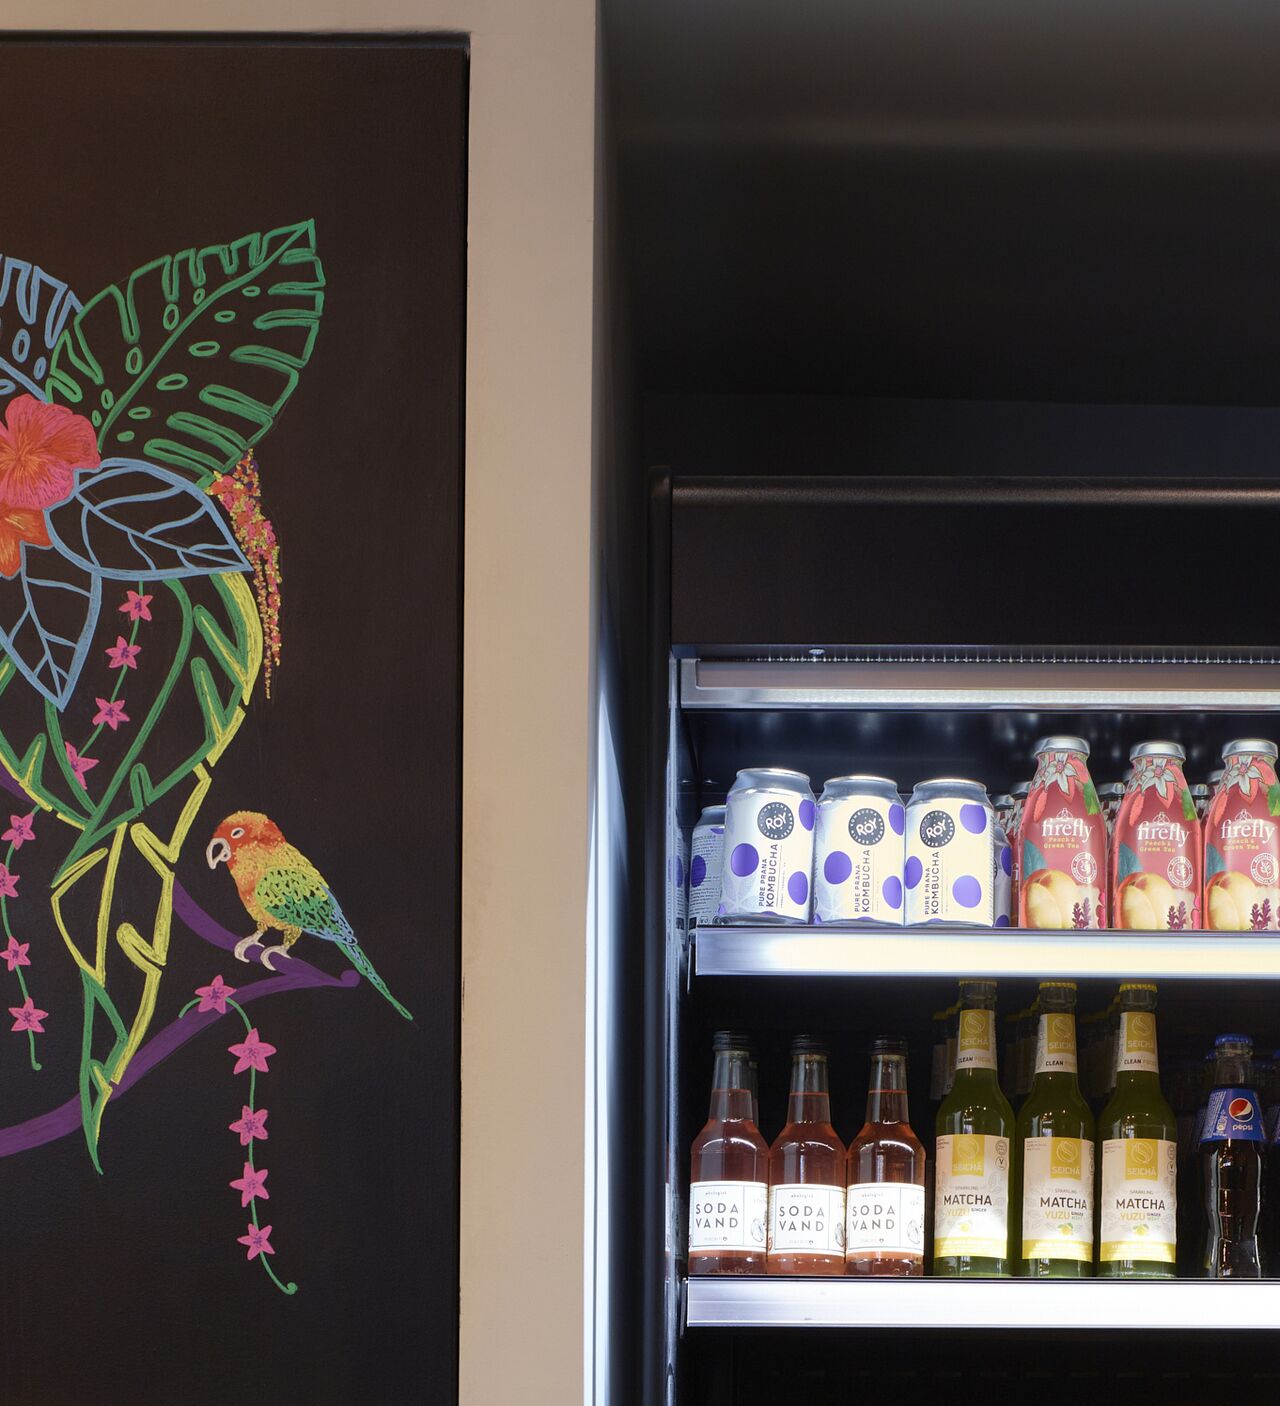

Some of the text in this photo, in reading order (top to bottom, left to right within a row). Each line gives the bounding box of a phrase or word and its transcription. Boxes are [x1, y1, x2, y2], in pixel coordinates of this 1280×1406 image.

[1041, 819, 1093, 842] firefly
[1137, 821, 1190, 847] firefly
[1220, 819, 1277, 845] firefly
[765, 843, 778, 908] KOMBUCHA
[862, 849, 871, 913] KOMBUCHA
[758, 858, 768, 907] PURE PRANA
[930, 851, 940, 914] KOMBUCHA
[1232, 1123, 1254, 1135] pepsi
[943, 1194, 992, 1206] MATCHA
[1040, 1196, 1087, 1210] MATCHA
[1115, 1198, 1166, 1211] MATCHA
[695, 1202, 739, 1215] SODA
[779, 1205, 825, 1218] SODA
[852, 1204, 896, 1217] SODA
[695, 1217, 739, 1229] VAND
[779, 1220, 825, 1232] VAND
[852, 1218, 895, 1230] VAND
